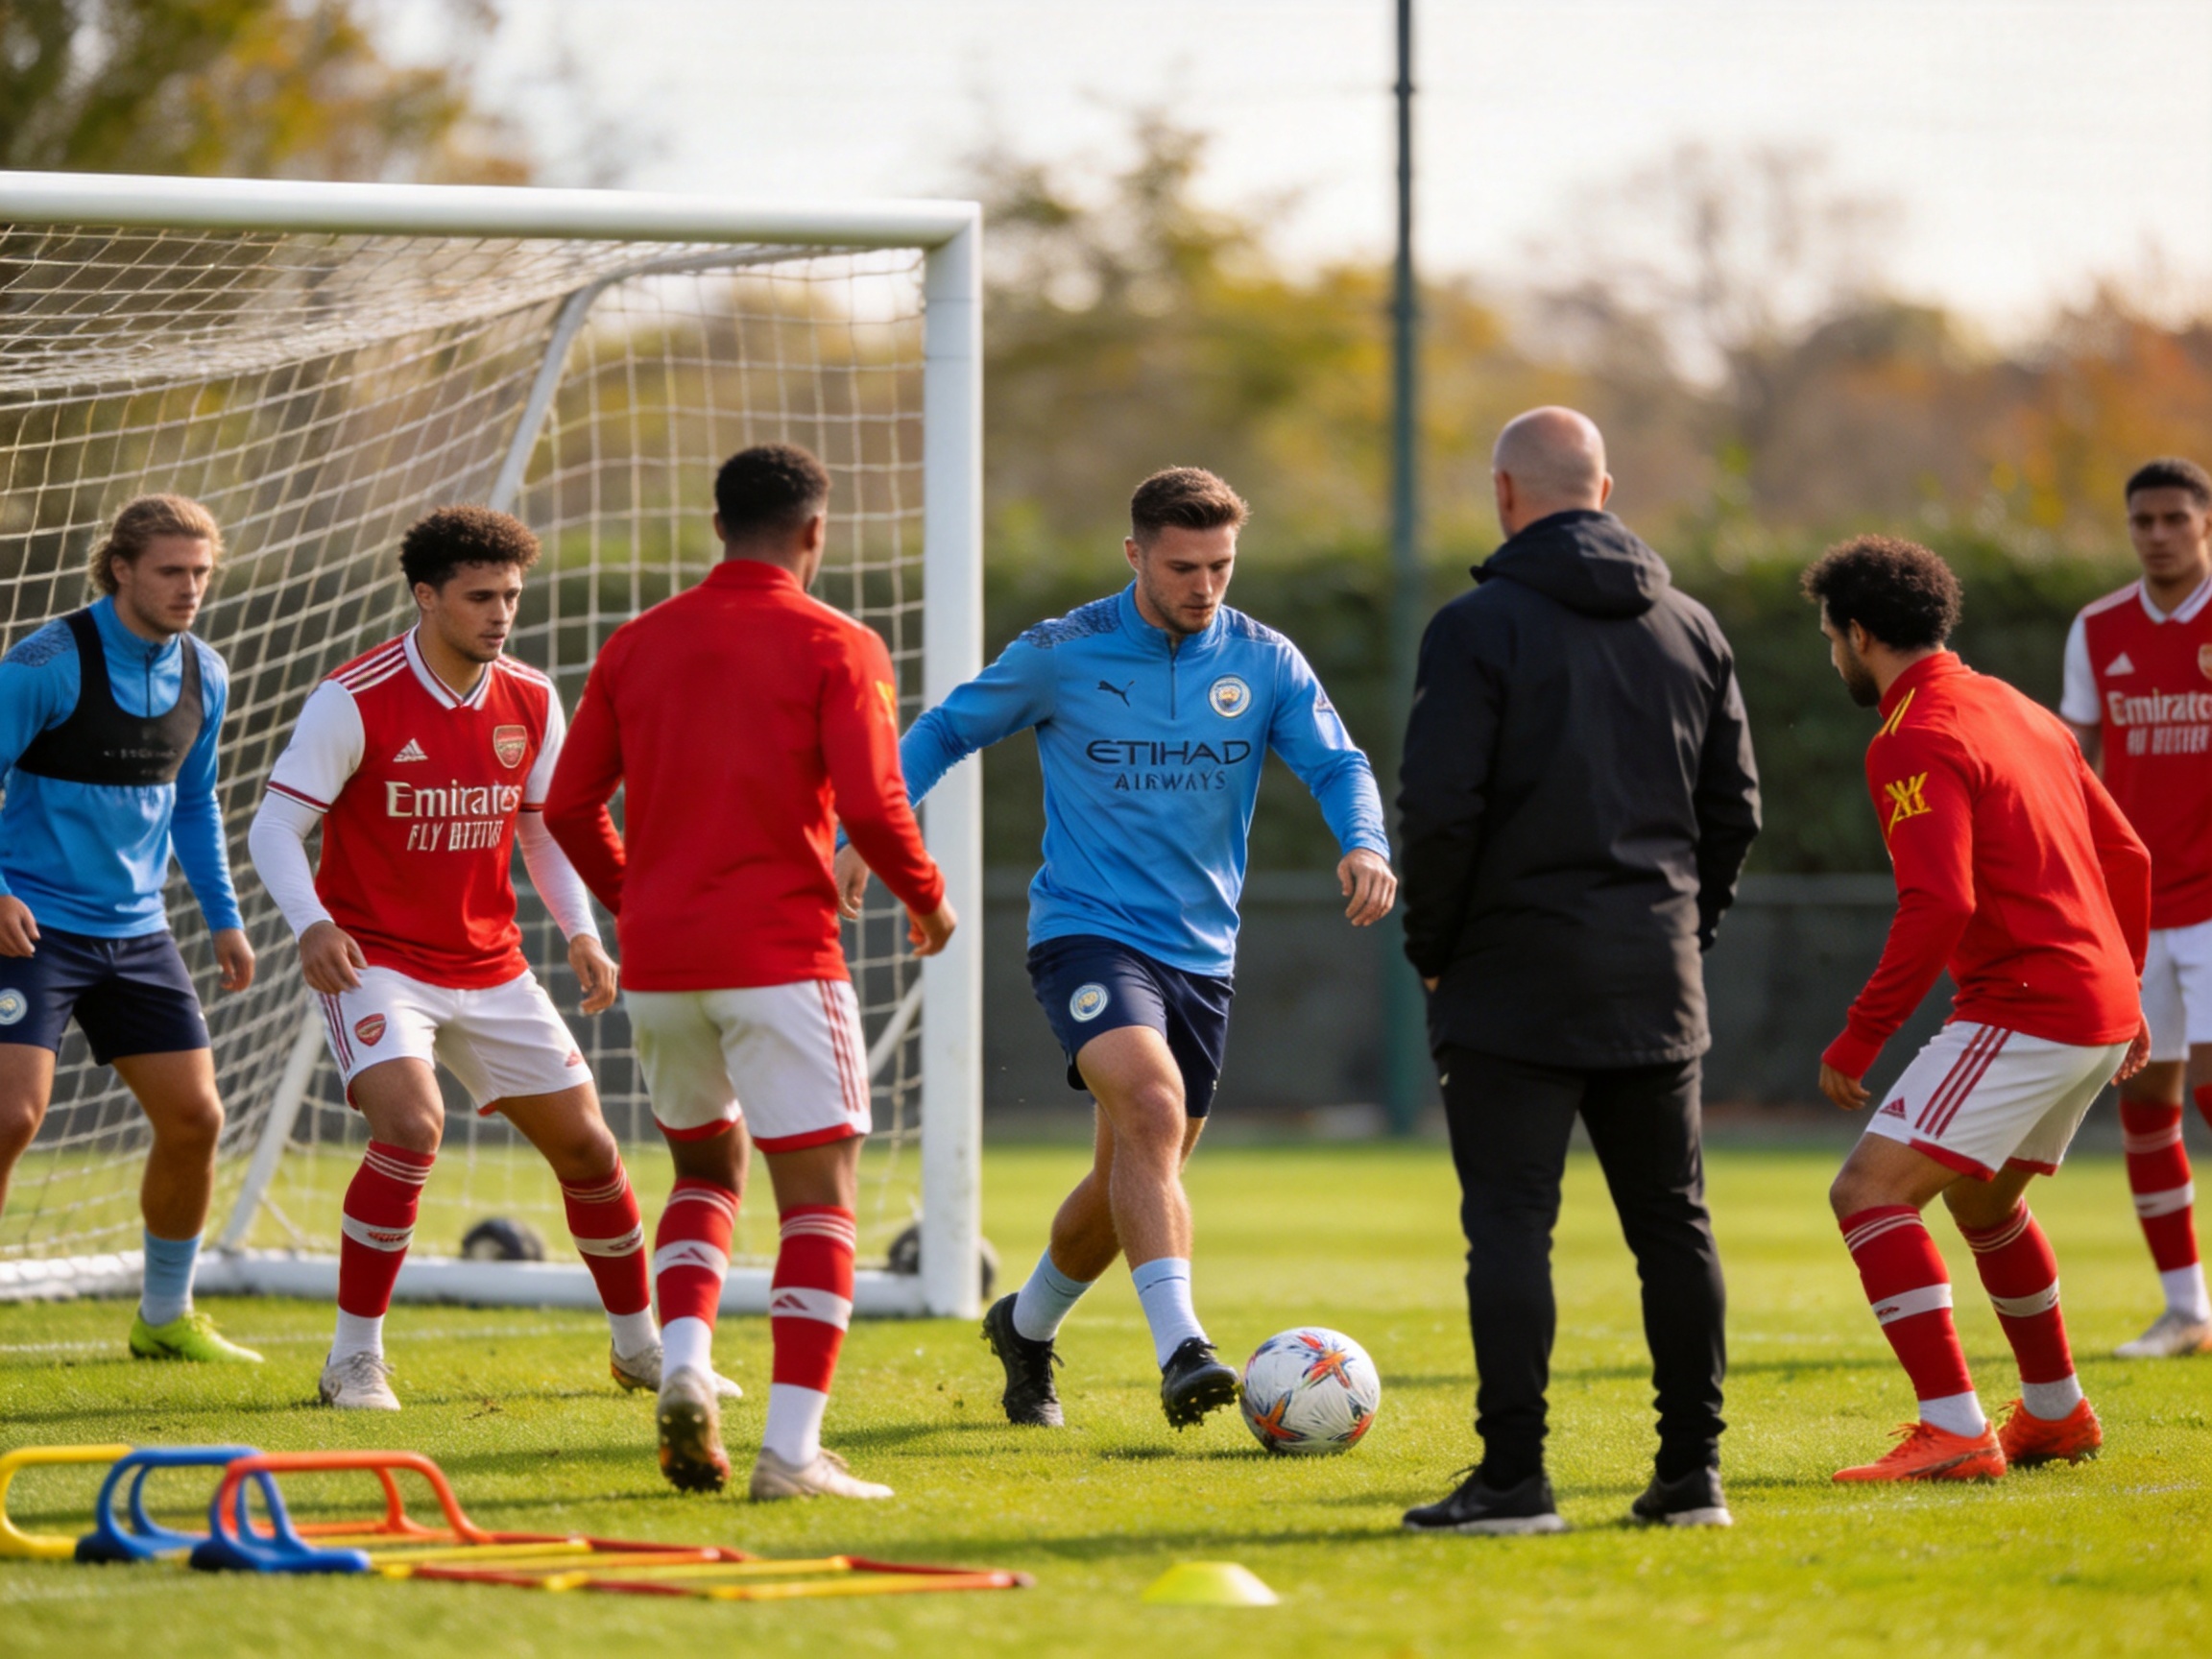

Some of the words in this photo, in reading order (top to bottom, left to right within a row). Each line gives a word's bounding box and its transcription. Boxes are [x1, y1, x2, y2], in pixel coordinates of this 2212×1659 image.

[2106, 687, 2212, 726] Emirate
[1086, 739, 1251, 766] ETIHAD
[1115, 770, 1227, 792] AIRWAYS
